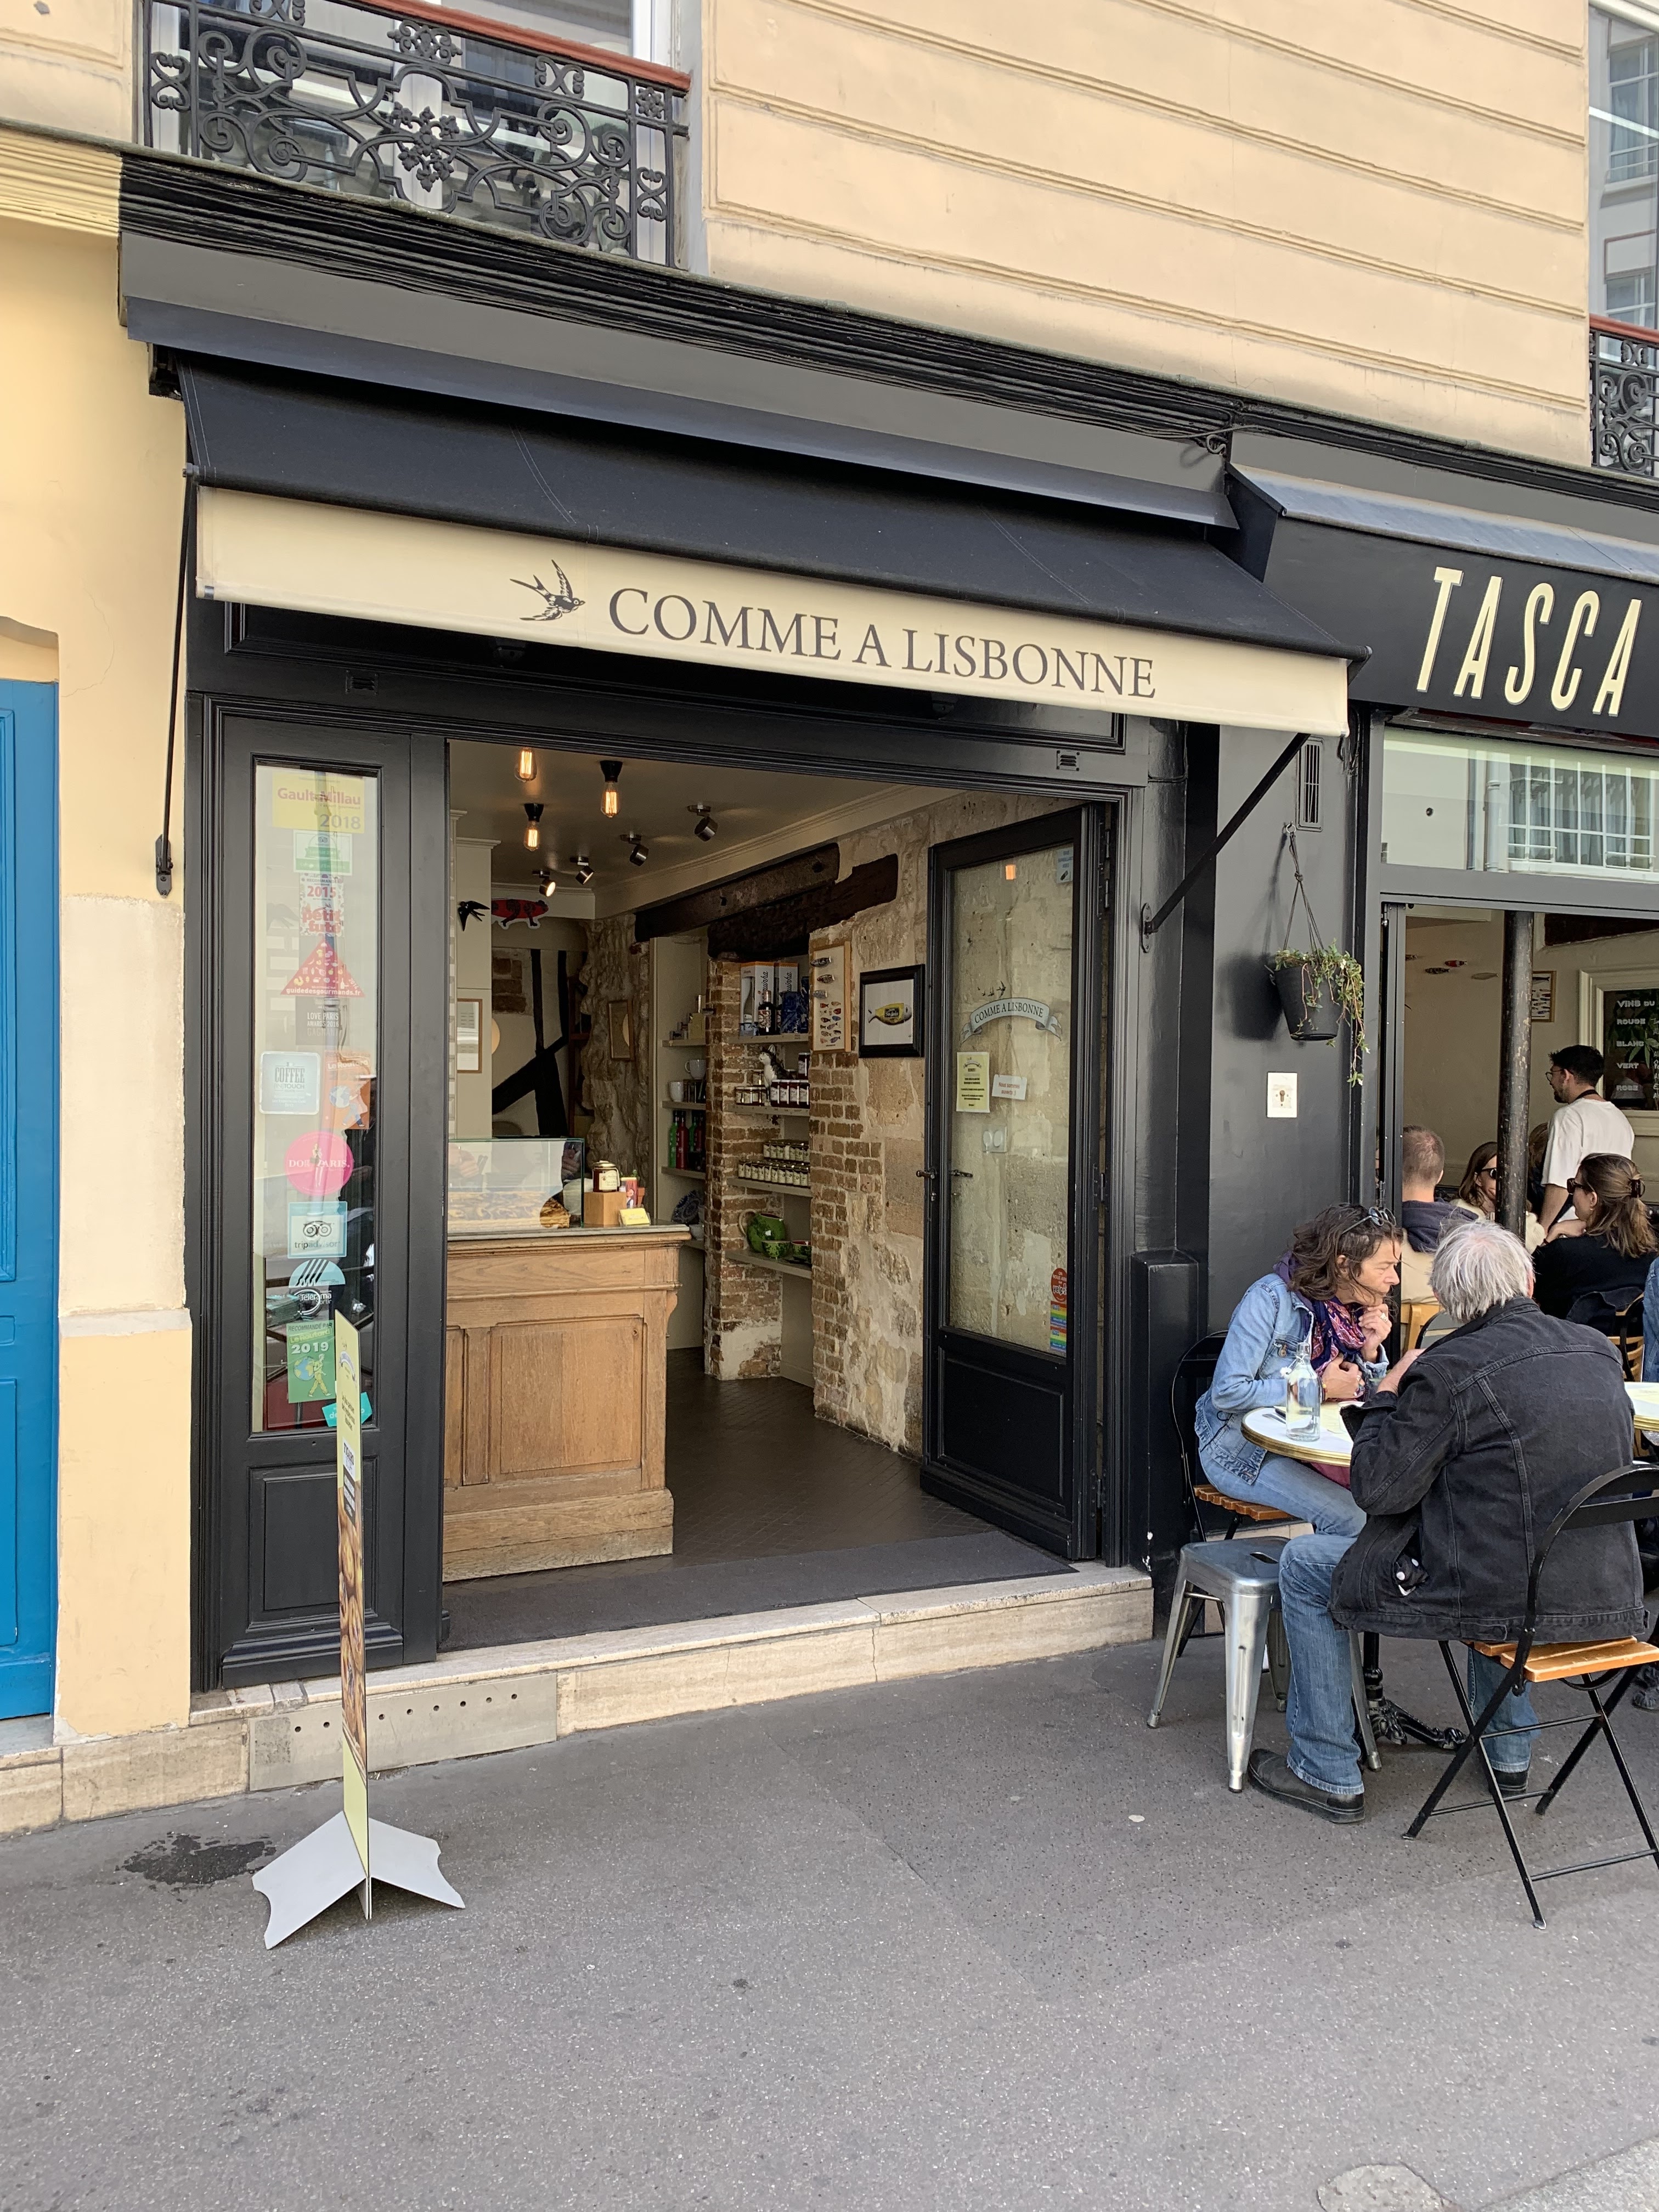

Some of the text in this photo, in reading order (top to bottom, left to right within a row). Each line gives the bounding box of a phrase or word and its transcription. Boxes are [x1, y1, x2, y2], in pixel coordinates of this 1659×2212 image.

[610, 588, 1156, 698] COMME A LISBONNE
[1417, 566, 1643, 717] TASCA
[320, 814, 361, 830] 2018
[307, 885, 336, 898] 2015
[286, 988, 361, 996] guidedesgourmands.fr
[974, 1002, 1044, 1024] COMME A LISBONNE
[275, 1066, 305, 1083] COFFEE
[295, 1240, 339, 1250] tripadvisor
[288, 1322, 321, 1331] RECOMMANDÉ
[300, 1329, 331, 1341] Routard
[291, 1342, 329, 1355] 2019
